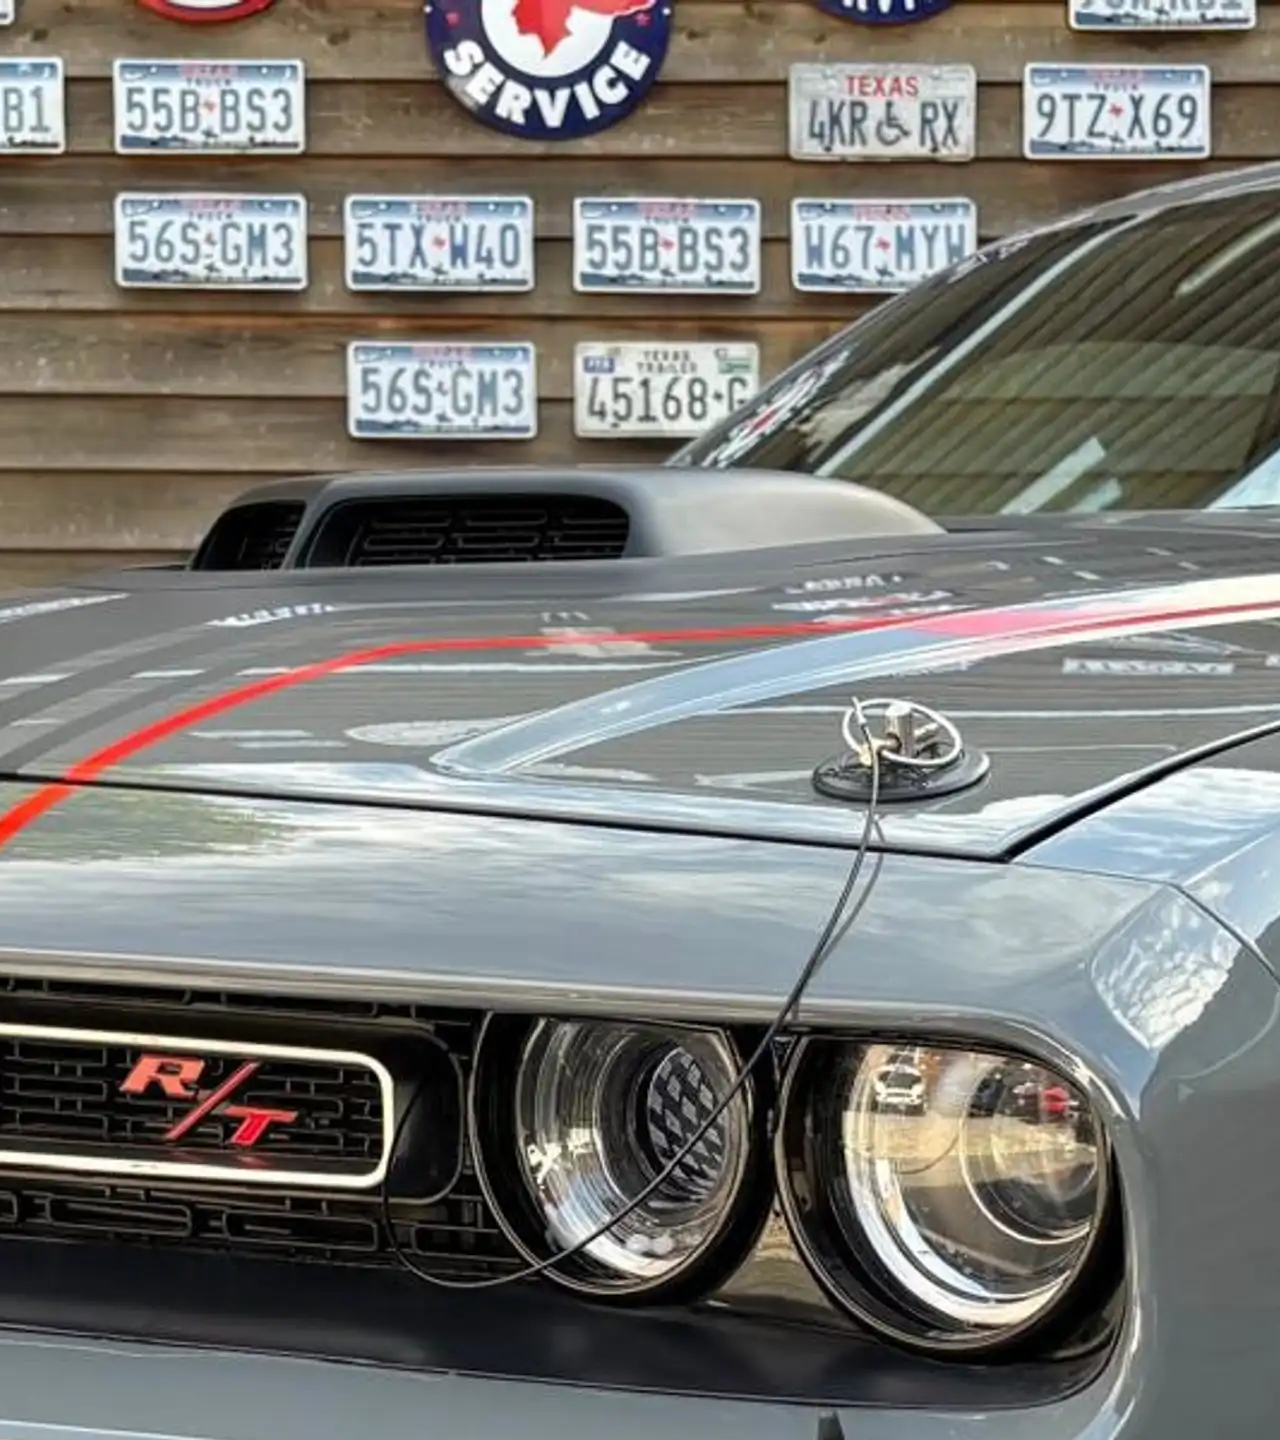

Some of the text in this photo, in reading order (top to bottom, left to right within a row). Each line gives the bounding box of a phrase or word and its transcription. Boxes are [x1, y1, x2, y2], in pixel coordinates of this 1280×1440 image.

[443, 40, 651, 127] SERVICE
[845, 75, 920, 97] TEXAS
[809, 99, 960, 148] 4KR RX
[118, 1053, 298, 1147] R/T
